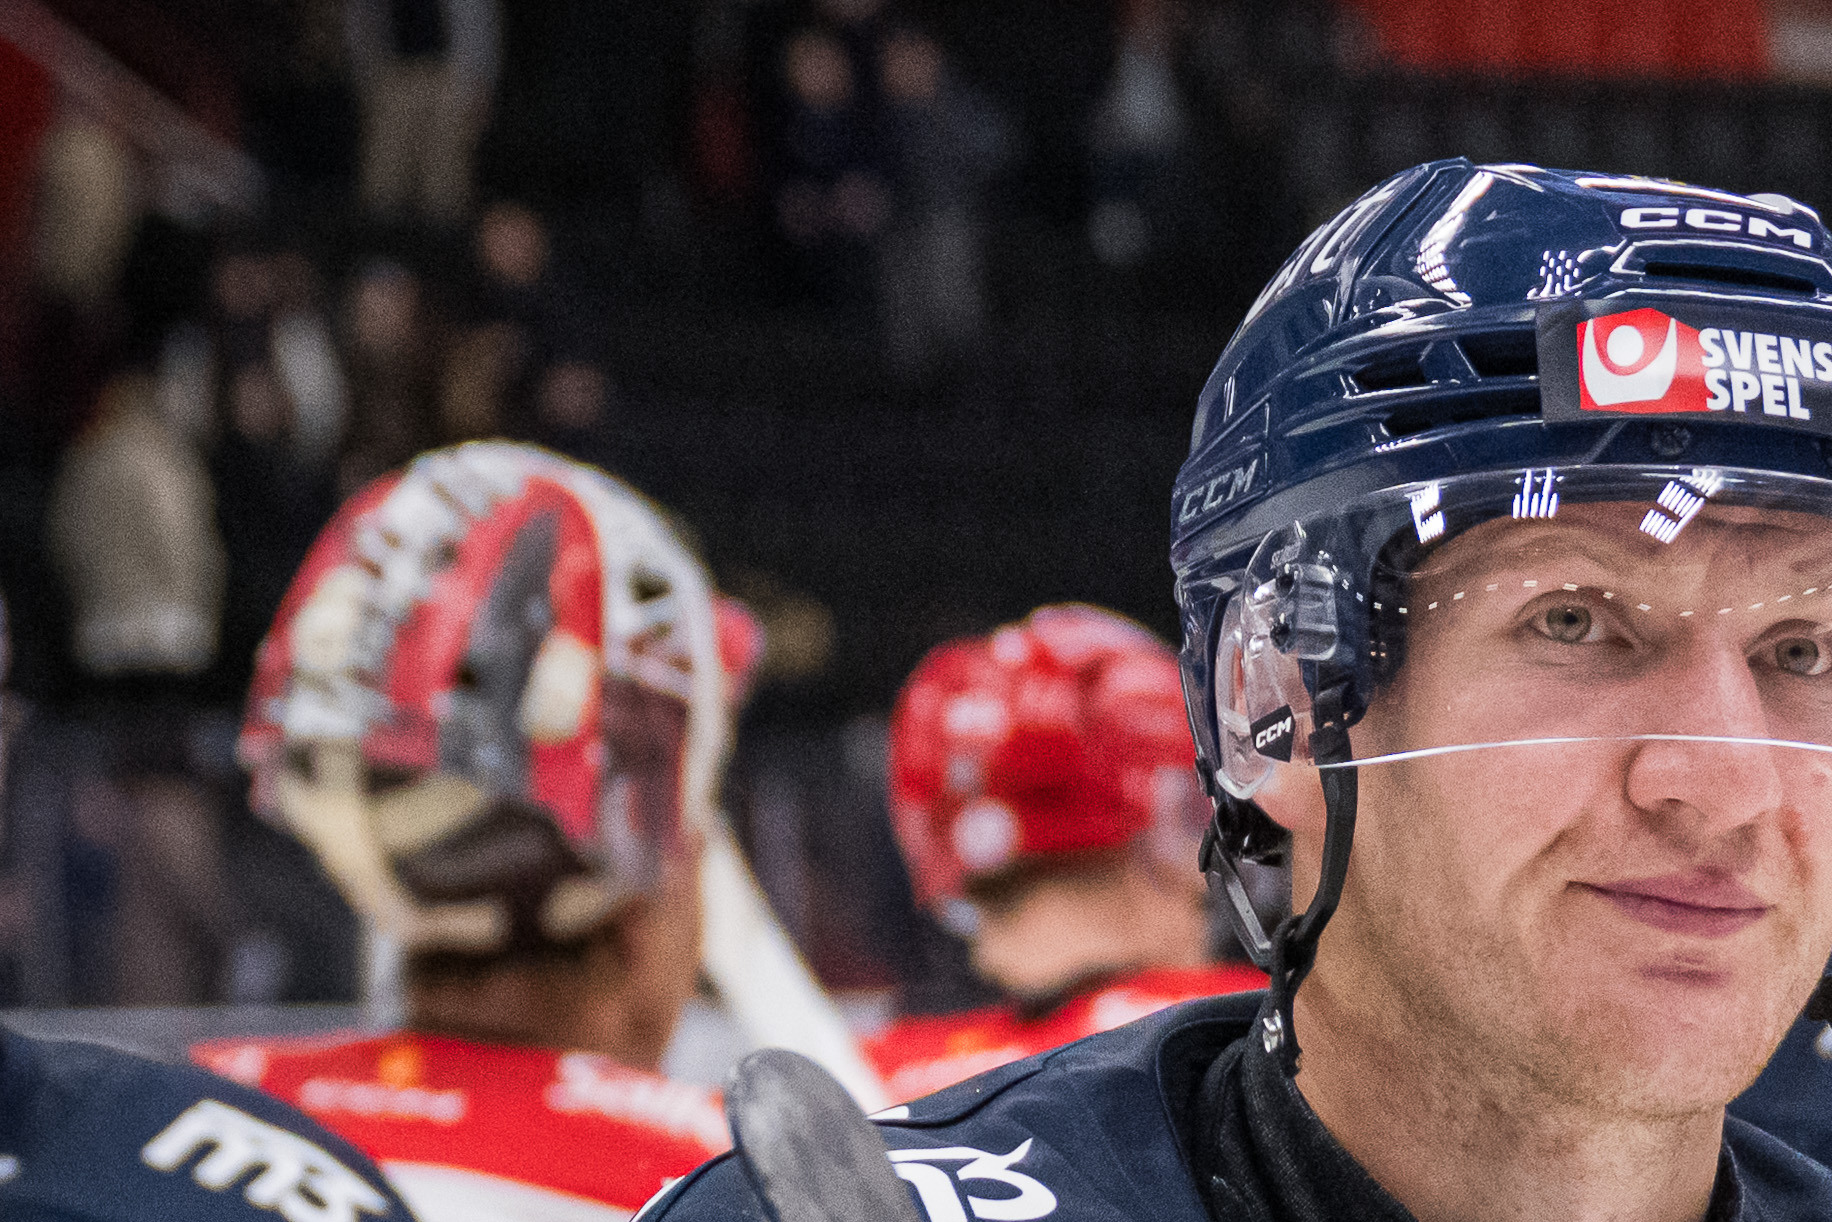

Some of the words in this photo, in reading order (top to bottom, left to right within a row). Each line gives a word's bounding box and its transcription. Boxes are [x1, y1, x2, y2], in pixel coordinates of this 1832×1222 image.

[1619, 206, 1812, 249] CCM
[1704, 368, 1812, 420] SPEL
[1178, 458, 1259, 524] CCM
[1255, 715, 1292, 749] CCM
